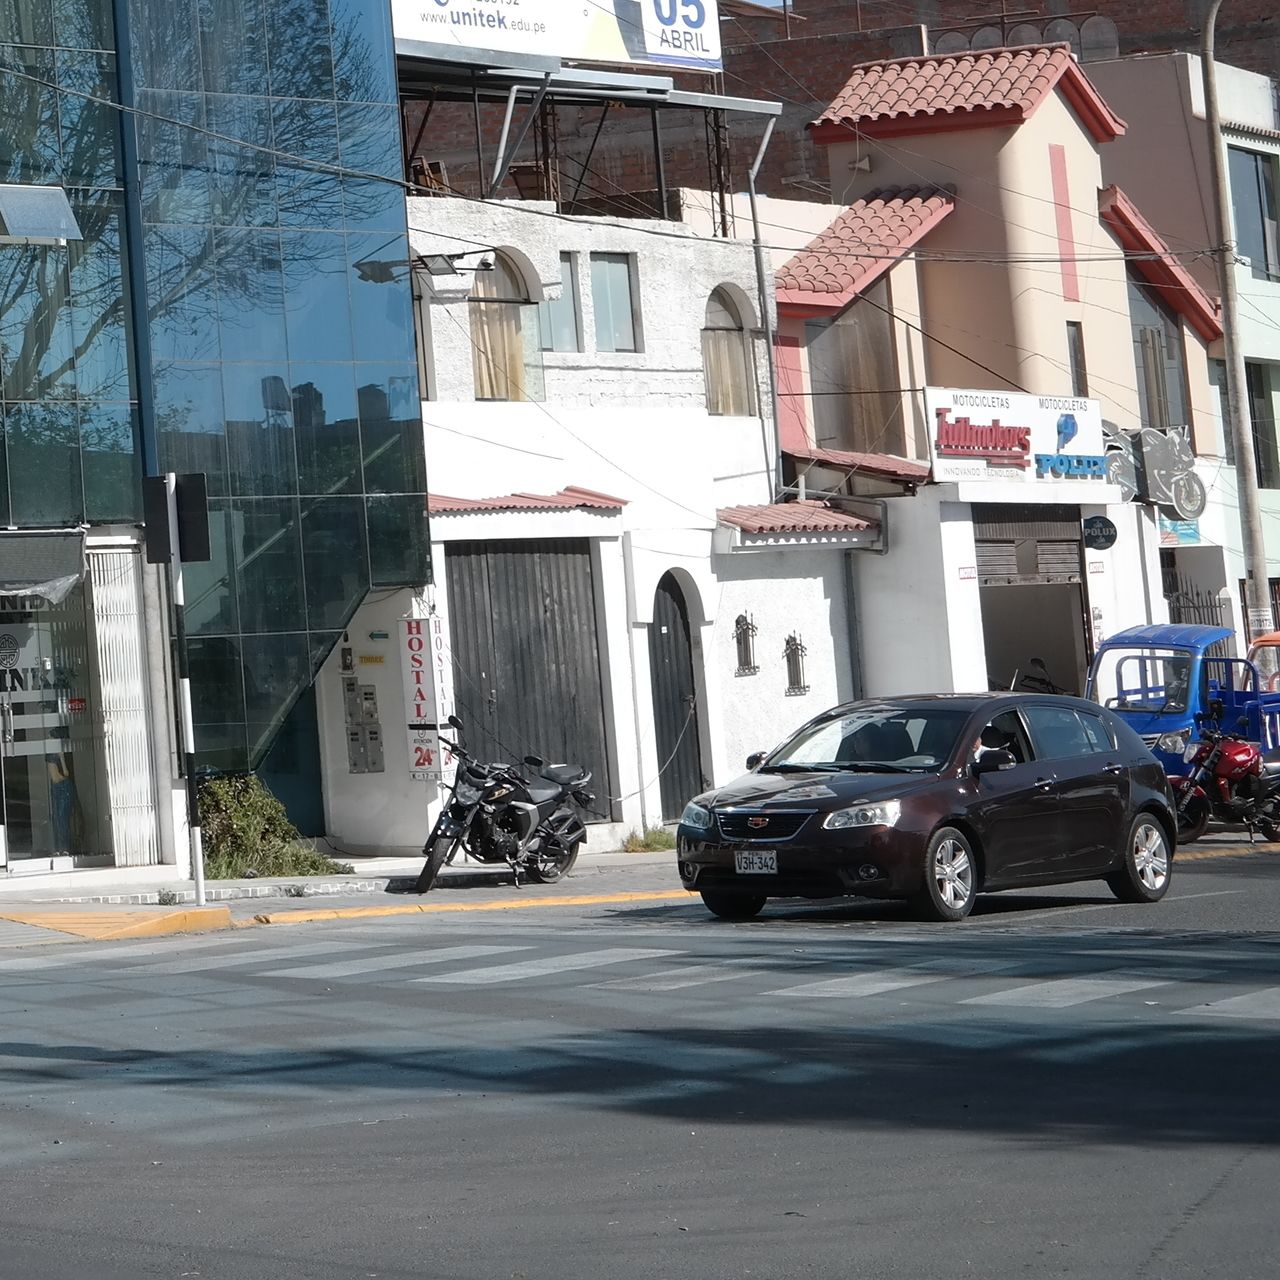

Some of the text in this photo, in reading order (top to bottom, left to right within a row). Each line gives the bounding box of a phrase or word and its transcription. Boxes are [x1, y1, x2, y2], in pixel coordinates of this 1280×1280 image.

[419, 6, 548, 35] www.unitek.edu.pe
[658, 27, 712, 55] ABRIL
[952, 394, 1010, 410] MOTOCICLETAS
[1038, 397, 1088, 412] MOTOCICLETAS
[943, 467, 980, 479] INNOVANDO
[1084, 528, 1116, 537] POLUX
[405, 620, 428, 720] HOSTAL
[433, 620, 449, 718] HOSTAL
[736, 856, 776, 871] V3H-342
